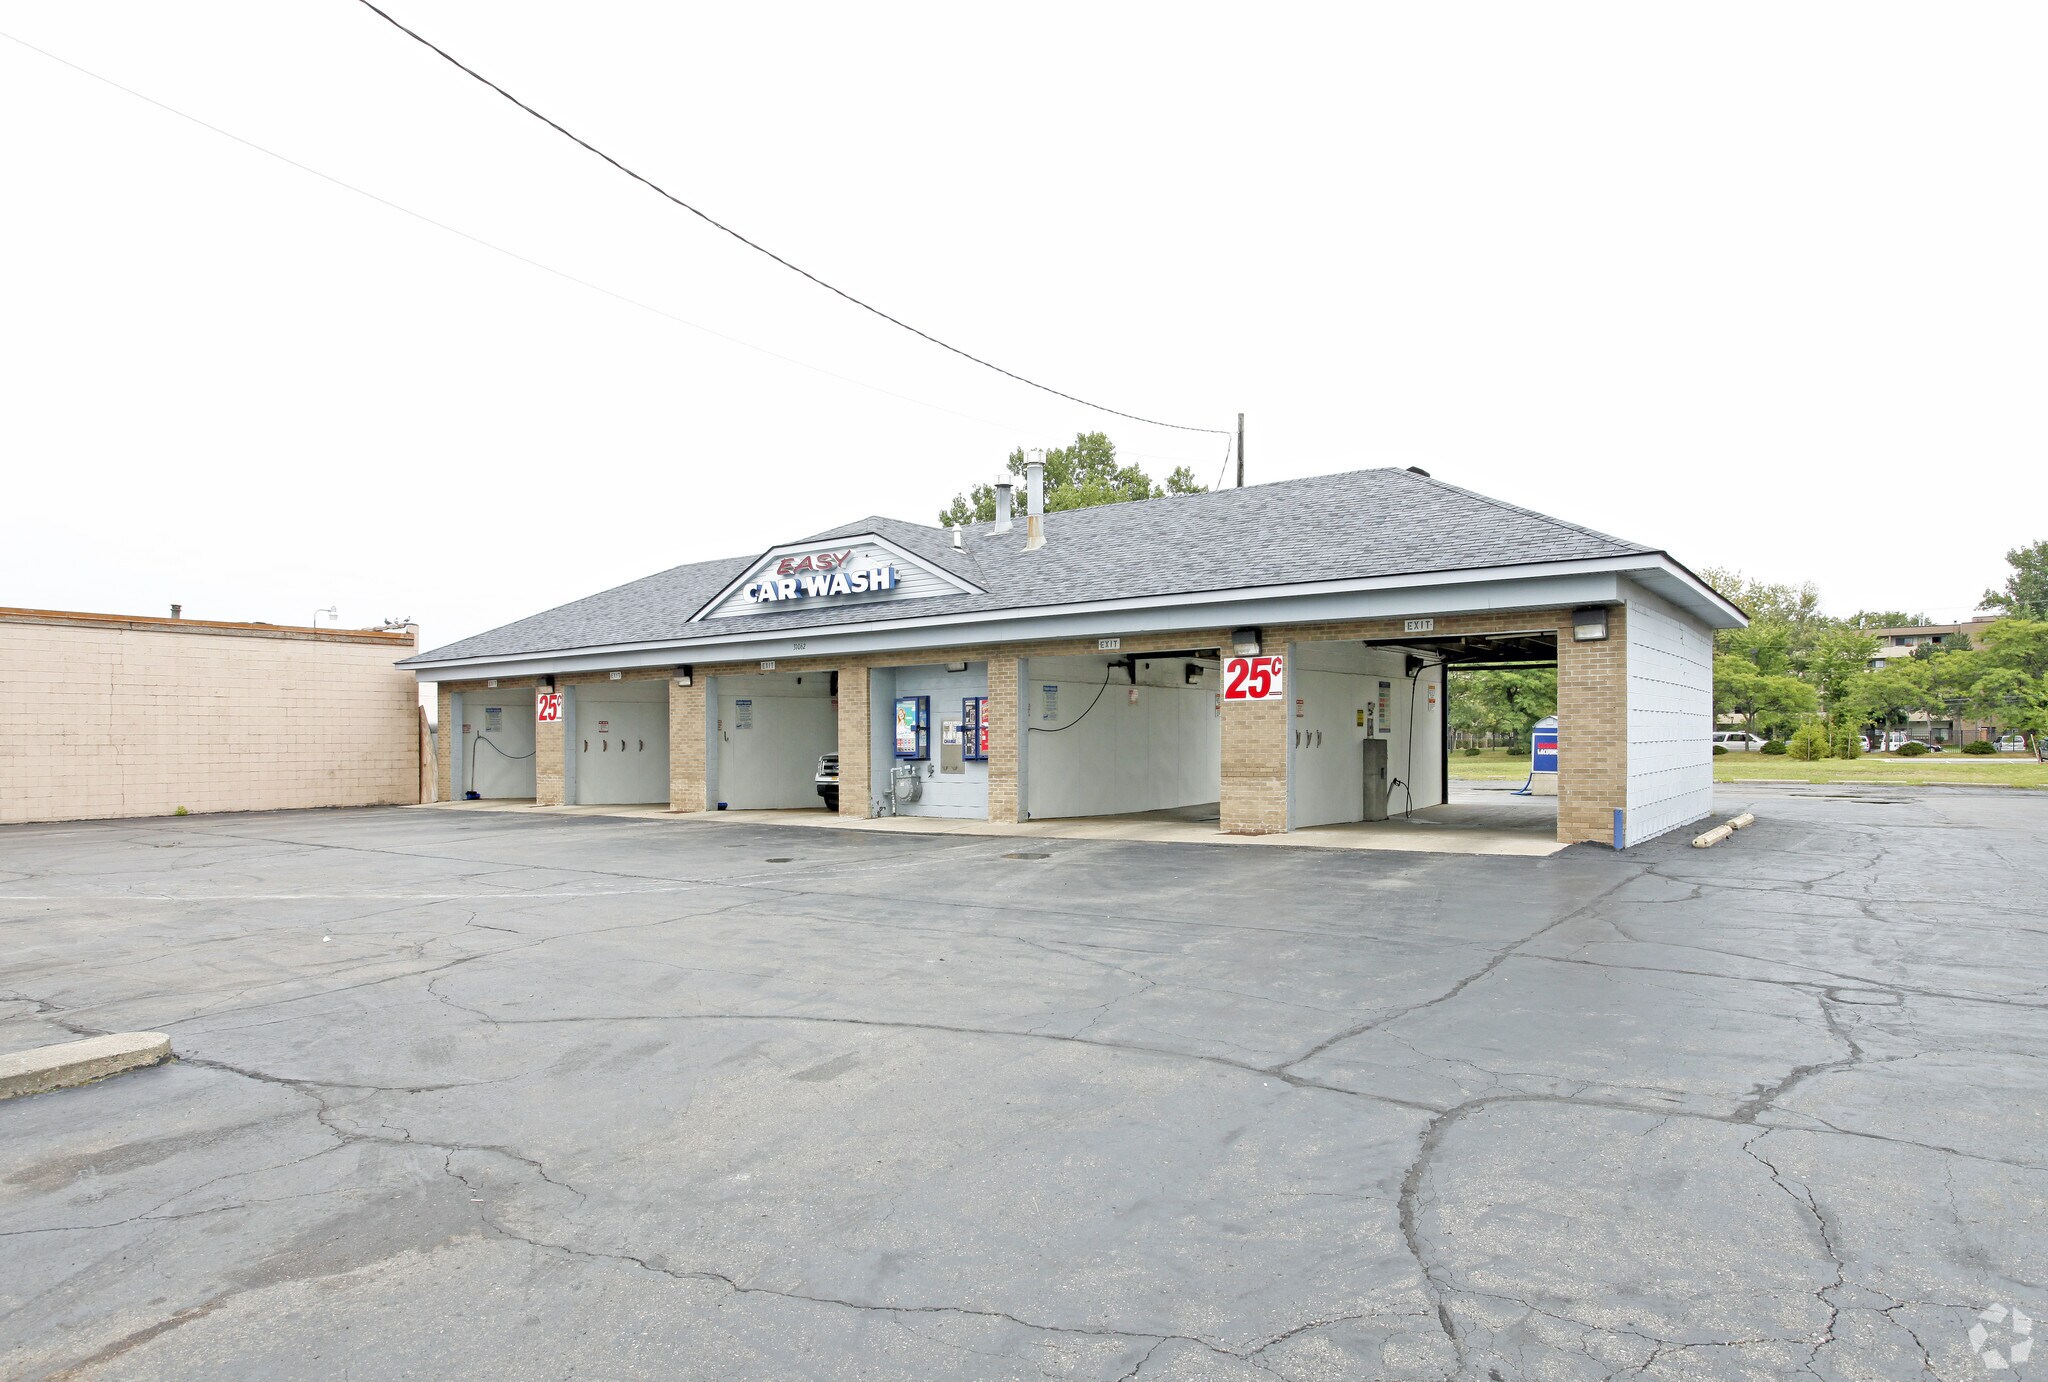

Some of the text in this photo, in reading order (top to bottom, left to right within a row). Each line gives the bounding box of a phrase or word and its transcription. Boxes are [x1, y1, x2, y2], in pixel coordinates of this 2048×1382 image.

[777, 549, 853, 575] EASY
[742, 566, 891, 603] CAR WASH
[1407, 620, 1430, 631] EXIT
[1100, 640, 1118, 649] EXIT
